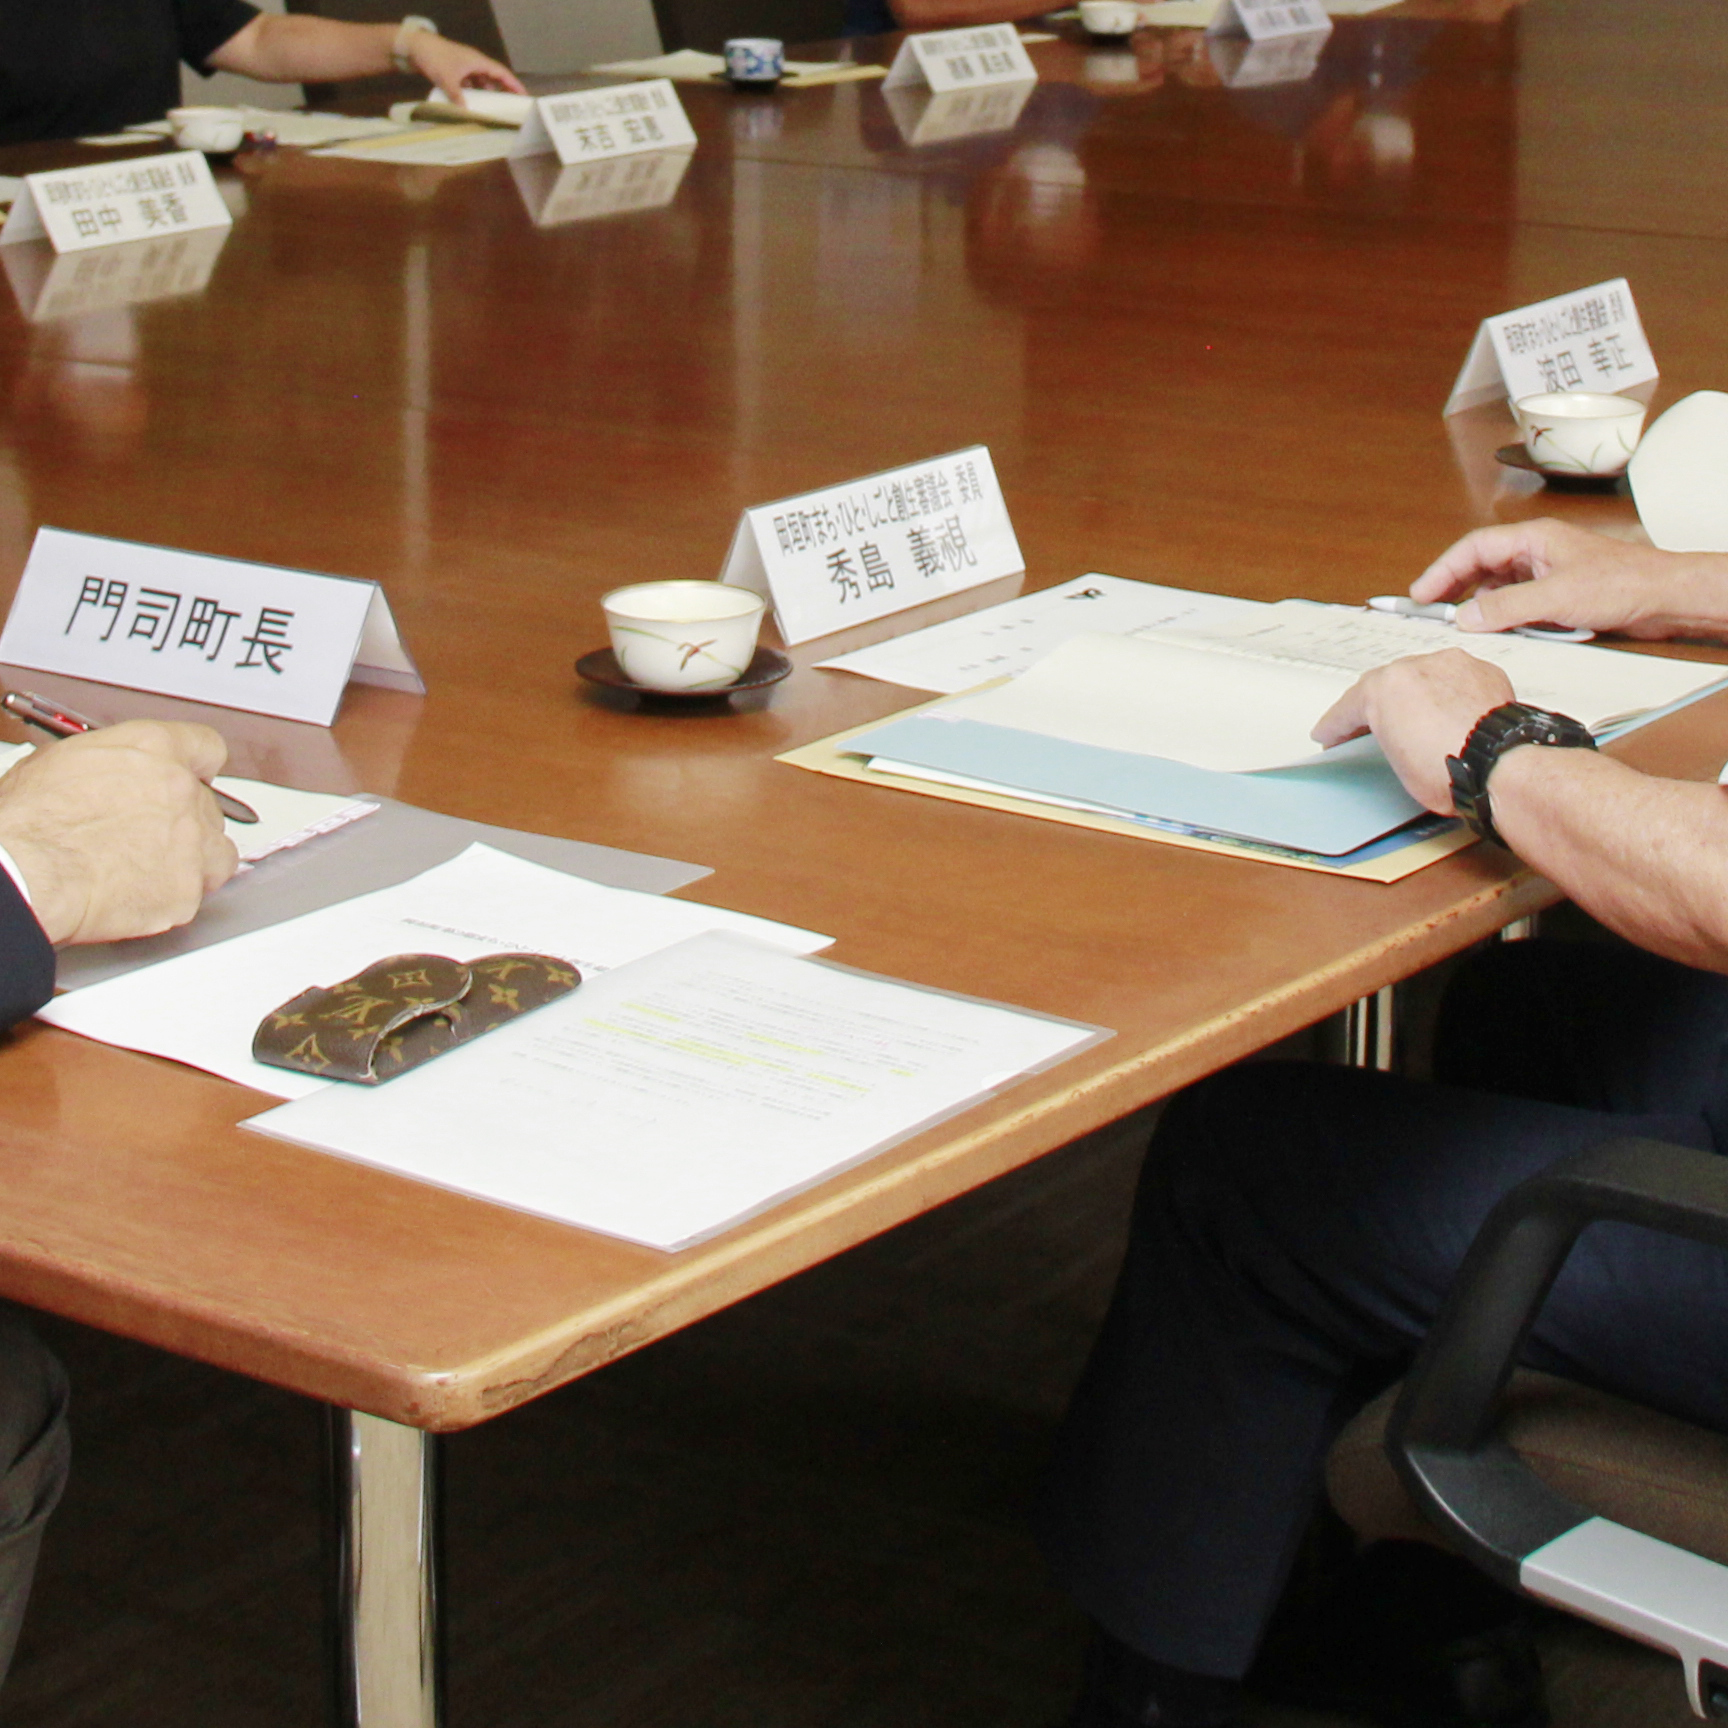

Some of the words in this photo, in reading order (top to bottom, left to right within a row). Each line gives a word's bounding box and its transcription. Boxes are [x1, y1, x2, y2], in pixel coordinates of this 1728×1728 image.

[71, 203, 122, 237] 田中
[825, 540, 896, 605] 秀島
[906, 513, 979, 578] 義視
[64, 574, 296, 676] 門司町長
